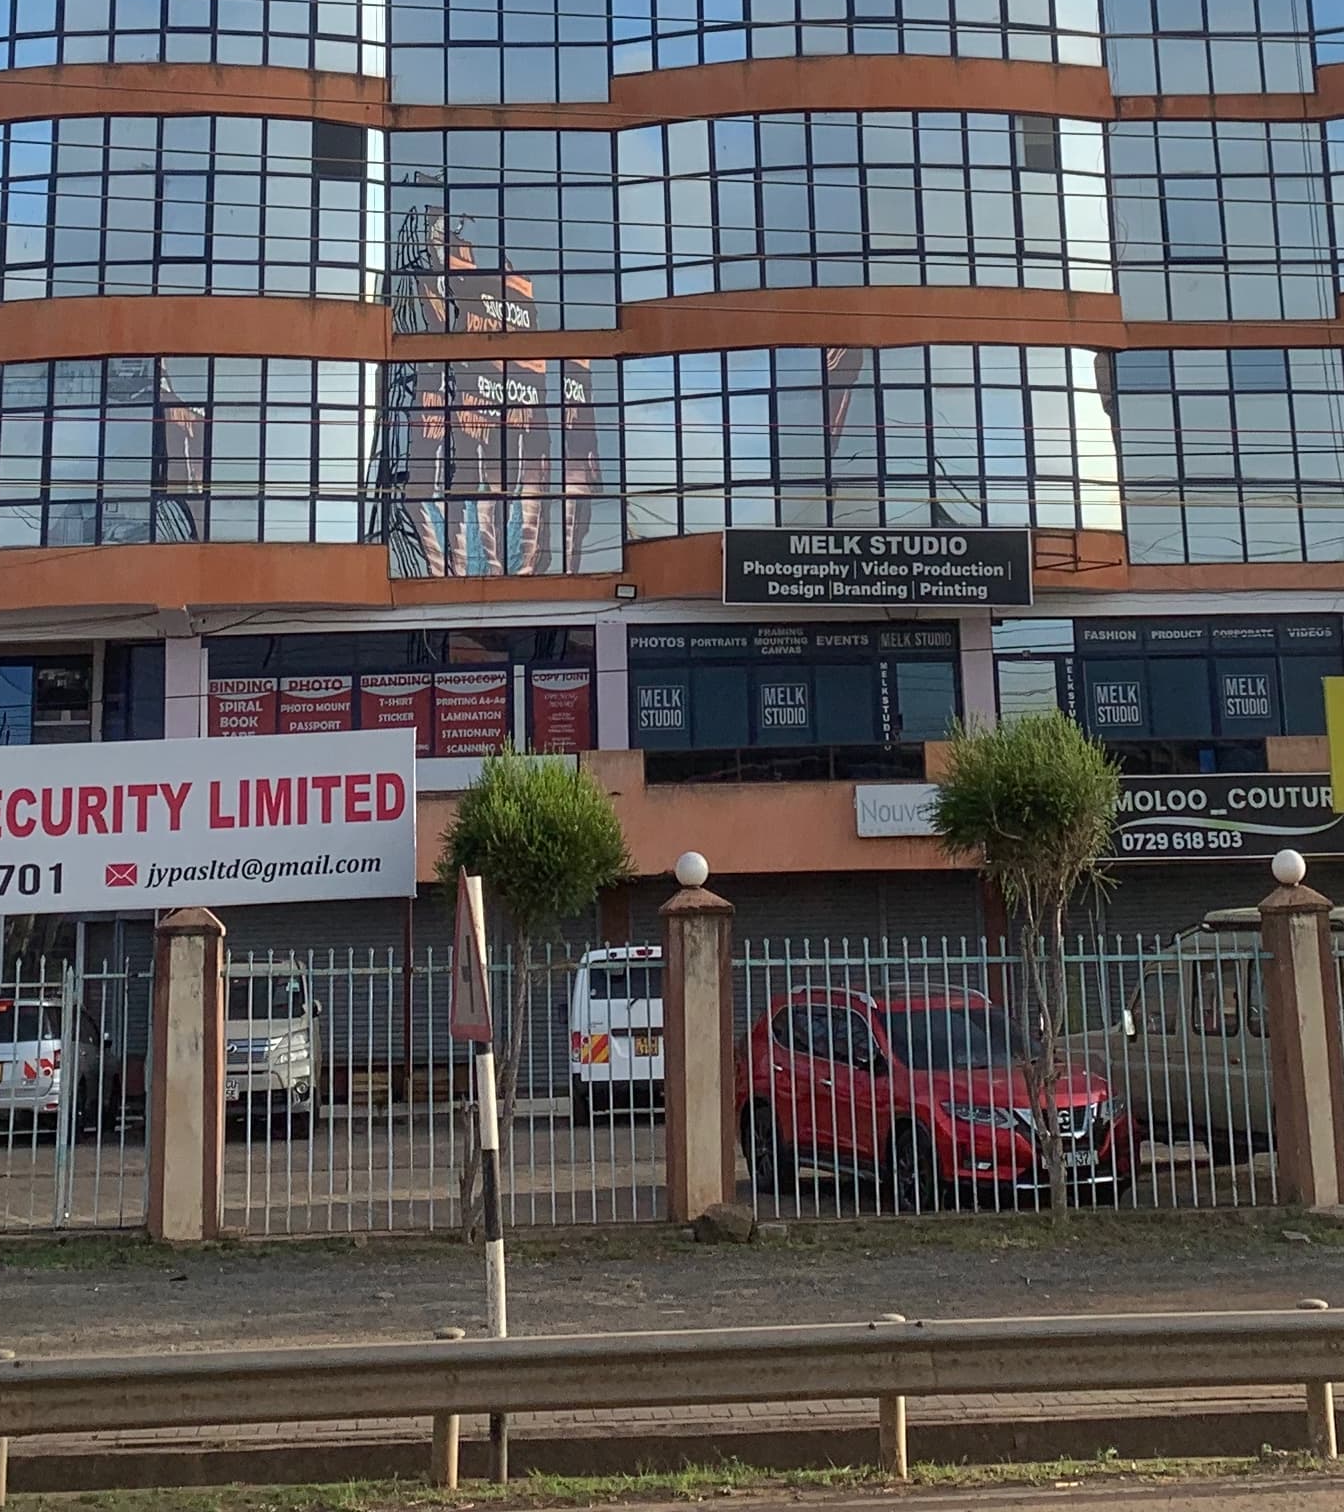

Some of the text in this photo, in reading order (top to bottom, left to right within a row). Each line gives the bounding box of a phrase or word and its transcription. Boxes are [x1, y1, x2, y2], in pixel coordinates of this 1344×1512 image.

[789, 536, 968, 556] MELK STUDIO
[743, 561, 849, 579] Photography
[861, 562, 909, 577] Video
[912, 562, 1004, 577] Production
[767, 581, 825, 598] Design
[919, 582, 988, 599] Printing
[816, 635, 869, 647] EVENTS
[881, 632, 952, 648] MELK STUDIO
[1084, 630, 1137, 640] FASHION
[1151, 629, 1203, 640] PRODUCT
[630, 637, 685, 648] PHOTOS
[690, 637, 748, 648] PORTRAITS
[209, 680, 274, 694] BINDING
[288, 679, 343, 691] PHOTO
[361, 675, 432, 688] BRANDING
[1225, 678, 1267, 696] MELK
[640, 689, 682, 707] MELK
[763, 687, 805, 705] MELK
[1096, 685, 1137, 704] MELK
[219, 700, 264, 713] SPIRAL
[280, 702, 351, 713] PHOTO MOUNT
[379, 697, 414, 707] T-SHIRT
[436, 697, 478, 706] PRINTING
[1227, 698, 1269, 716] STUDIO
[378, 712, 414, 722] STICKER
[441, 711, 502, 721] LAMINATION
[640, 709, 683, 728] STUDIO
[764, 707, 806, 726] STUDIO
[1097, 706, 1139, 724] STUDIO
[220, 716, 259, 728] BOOK
[289, 720, 342, 731] PASSPORT
[442, 728, 501, 738] STATIONARY
[210, 772, 406, 829] LIMITED
[1122, 830, 1243, 851] 0729 618 503
[145, 854, 382, 889] jypasltd@gmail.com
